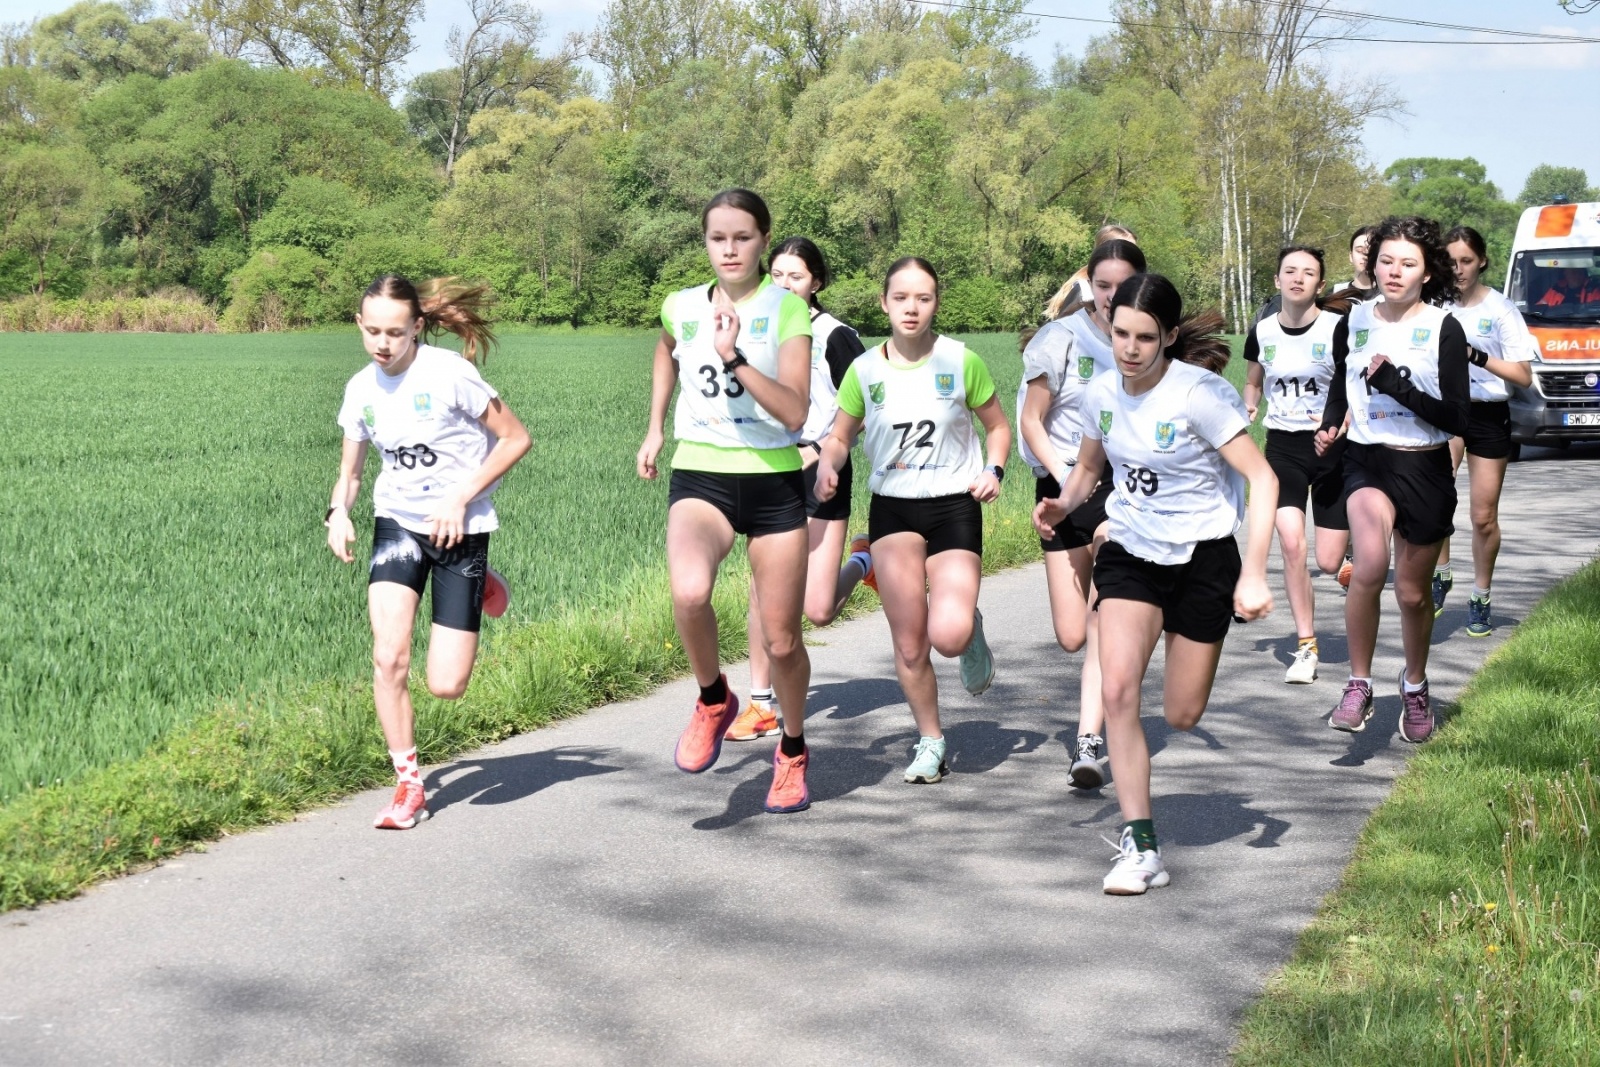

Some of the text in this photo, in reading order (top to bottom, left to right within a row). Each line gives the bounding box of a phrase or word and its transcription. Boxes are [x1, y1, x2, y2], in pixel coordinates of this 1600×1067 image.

[698, 364, 745, 399] 33
[1275, 376, 1320, 398] 114
[892, 419, 936, 450] 72
[1569, 414, 1588, 425] SWD
[1121, 463, 1159, 497] 39
